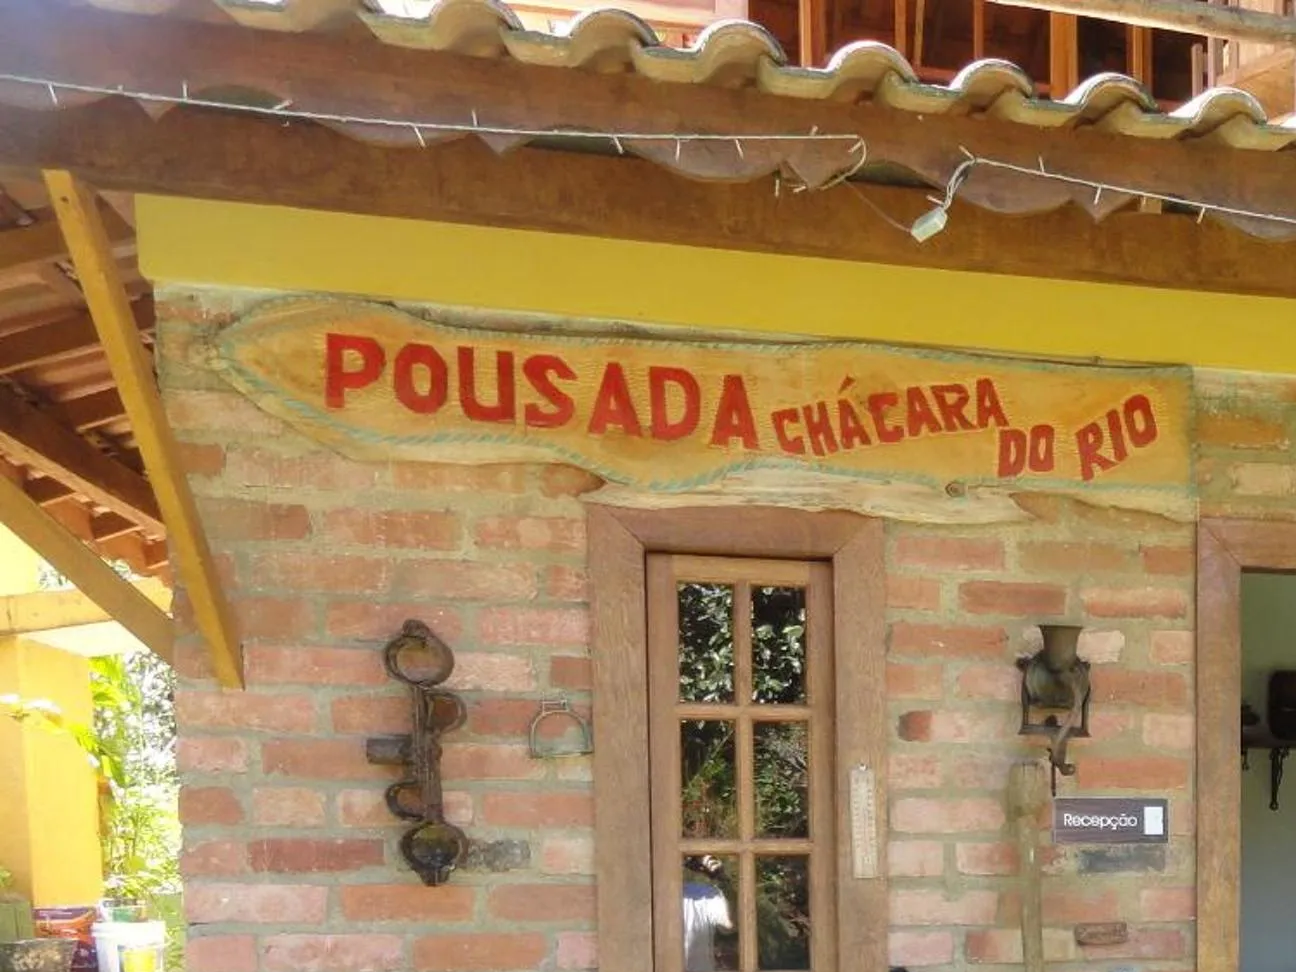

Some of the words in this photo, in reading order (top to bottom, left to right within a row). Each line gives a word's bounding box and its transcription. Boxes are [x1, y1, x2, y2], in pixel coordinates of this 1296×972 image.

[325, 332, 760, 450] POUSADA
[771, 375, 1009, 456] CHÁCARA
[998, 424, 1055, 478] DO
[1076, 394, 1158, 481] RIO
[1063, 812, 1138, 831] Recepção
